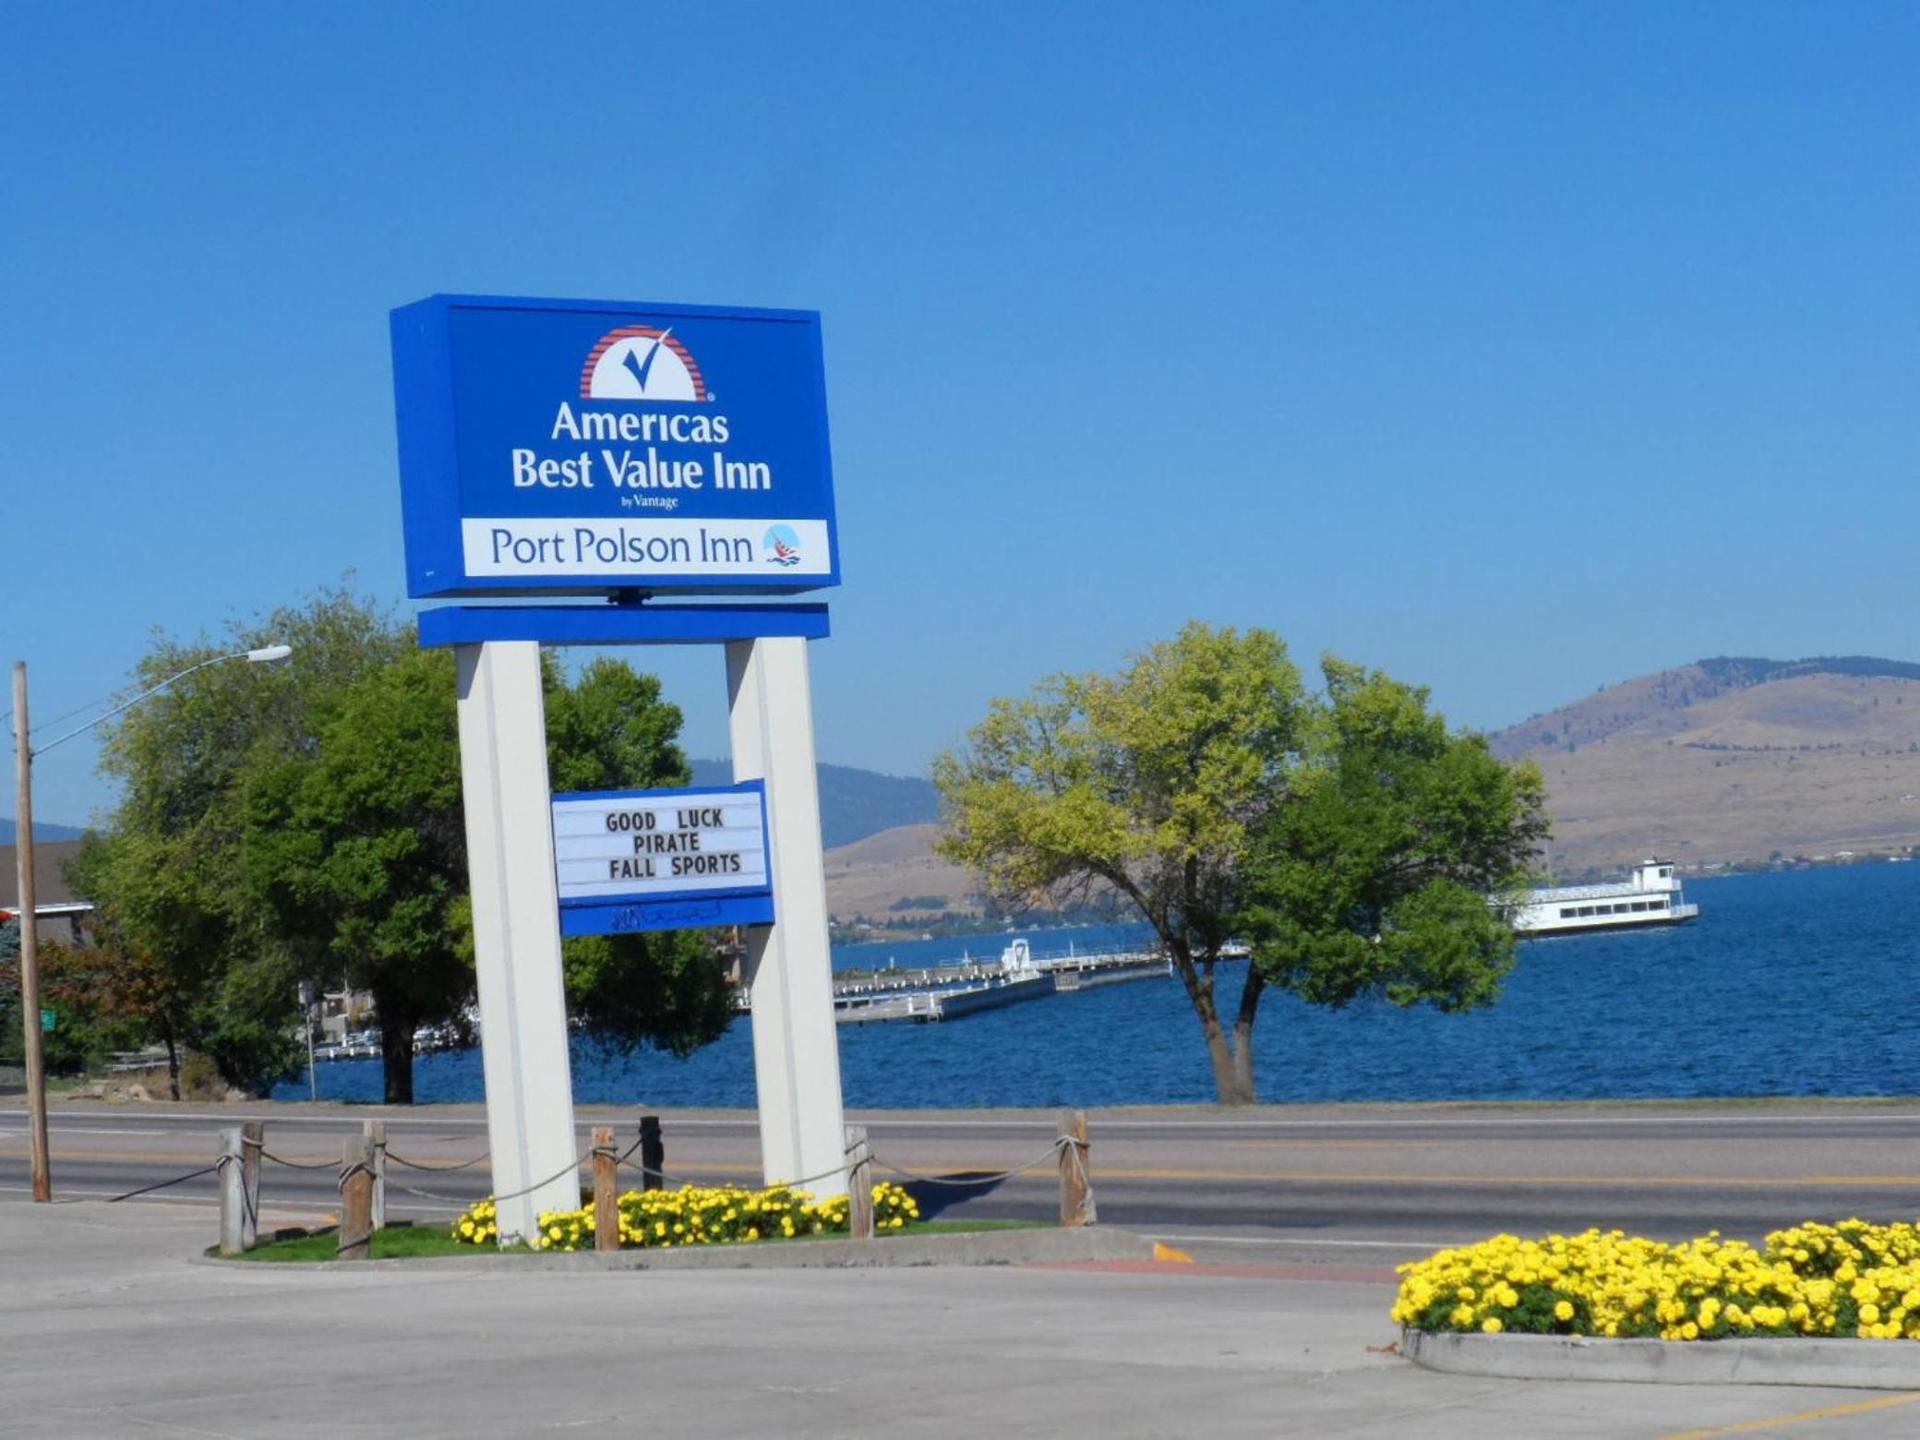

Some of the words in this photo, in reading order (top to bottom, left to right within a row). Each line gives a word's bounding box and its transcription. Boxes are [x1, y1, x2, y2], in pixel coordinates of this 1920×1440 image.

[551, 401, 729, 443] Americas
[512, 448, 594, 488] Best
[601, 447, 703, 489] Value
[713, 452, 771, 490] Inn
[621, 496, 632, 509] by
[633, 494, 679, 510] Vantage
[491, 528, 565, 563] Port
[574, 528, 691, 562] Polson
[699, 529, 754, 563] Inn
[606, 812, 656, 832] GOOD
[677, 809, 723, 828] LUCK
[633, 833, 700, 853] PIRATE
[609, 858, 655, 878] FALL
[671, 854, 741, 875] SPORTS
